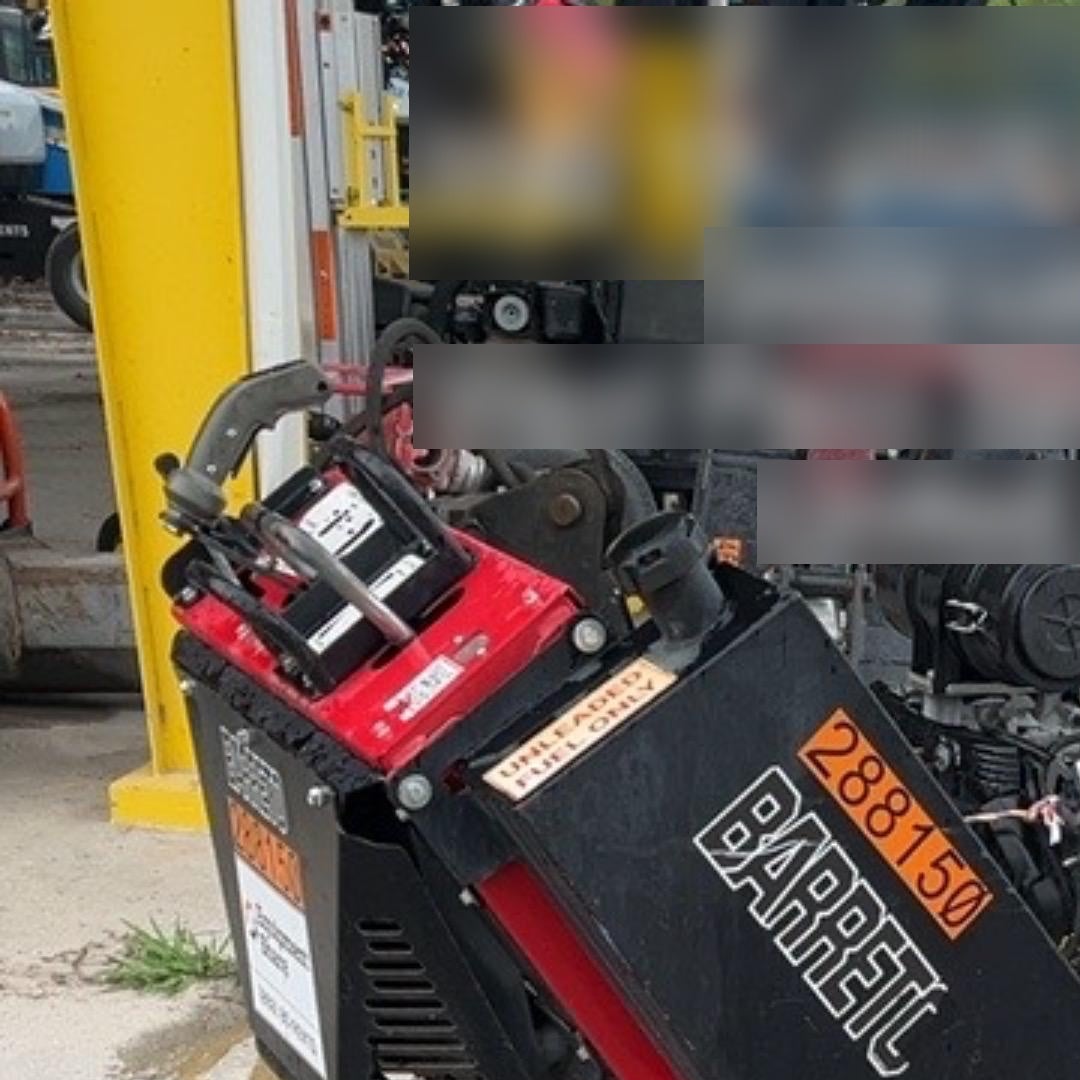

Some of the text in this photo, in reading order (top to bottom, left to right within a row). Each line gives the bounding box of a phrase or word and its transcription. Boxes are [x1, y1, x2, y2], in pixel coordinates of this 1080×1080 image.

[499, 670, 642, 778] UNLEADED
[515, 678, 654, 789] FUEL ONLY
[805, 721, 985, 928] 288150
